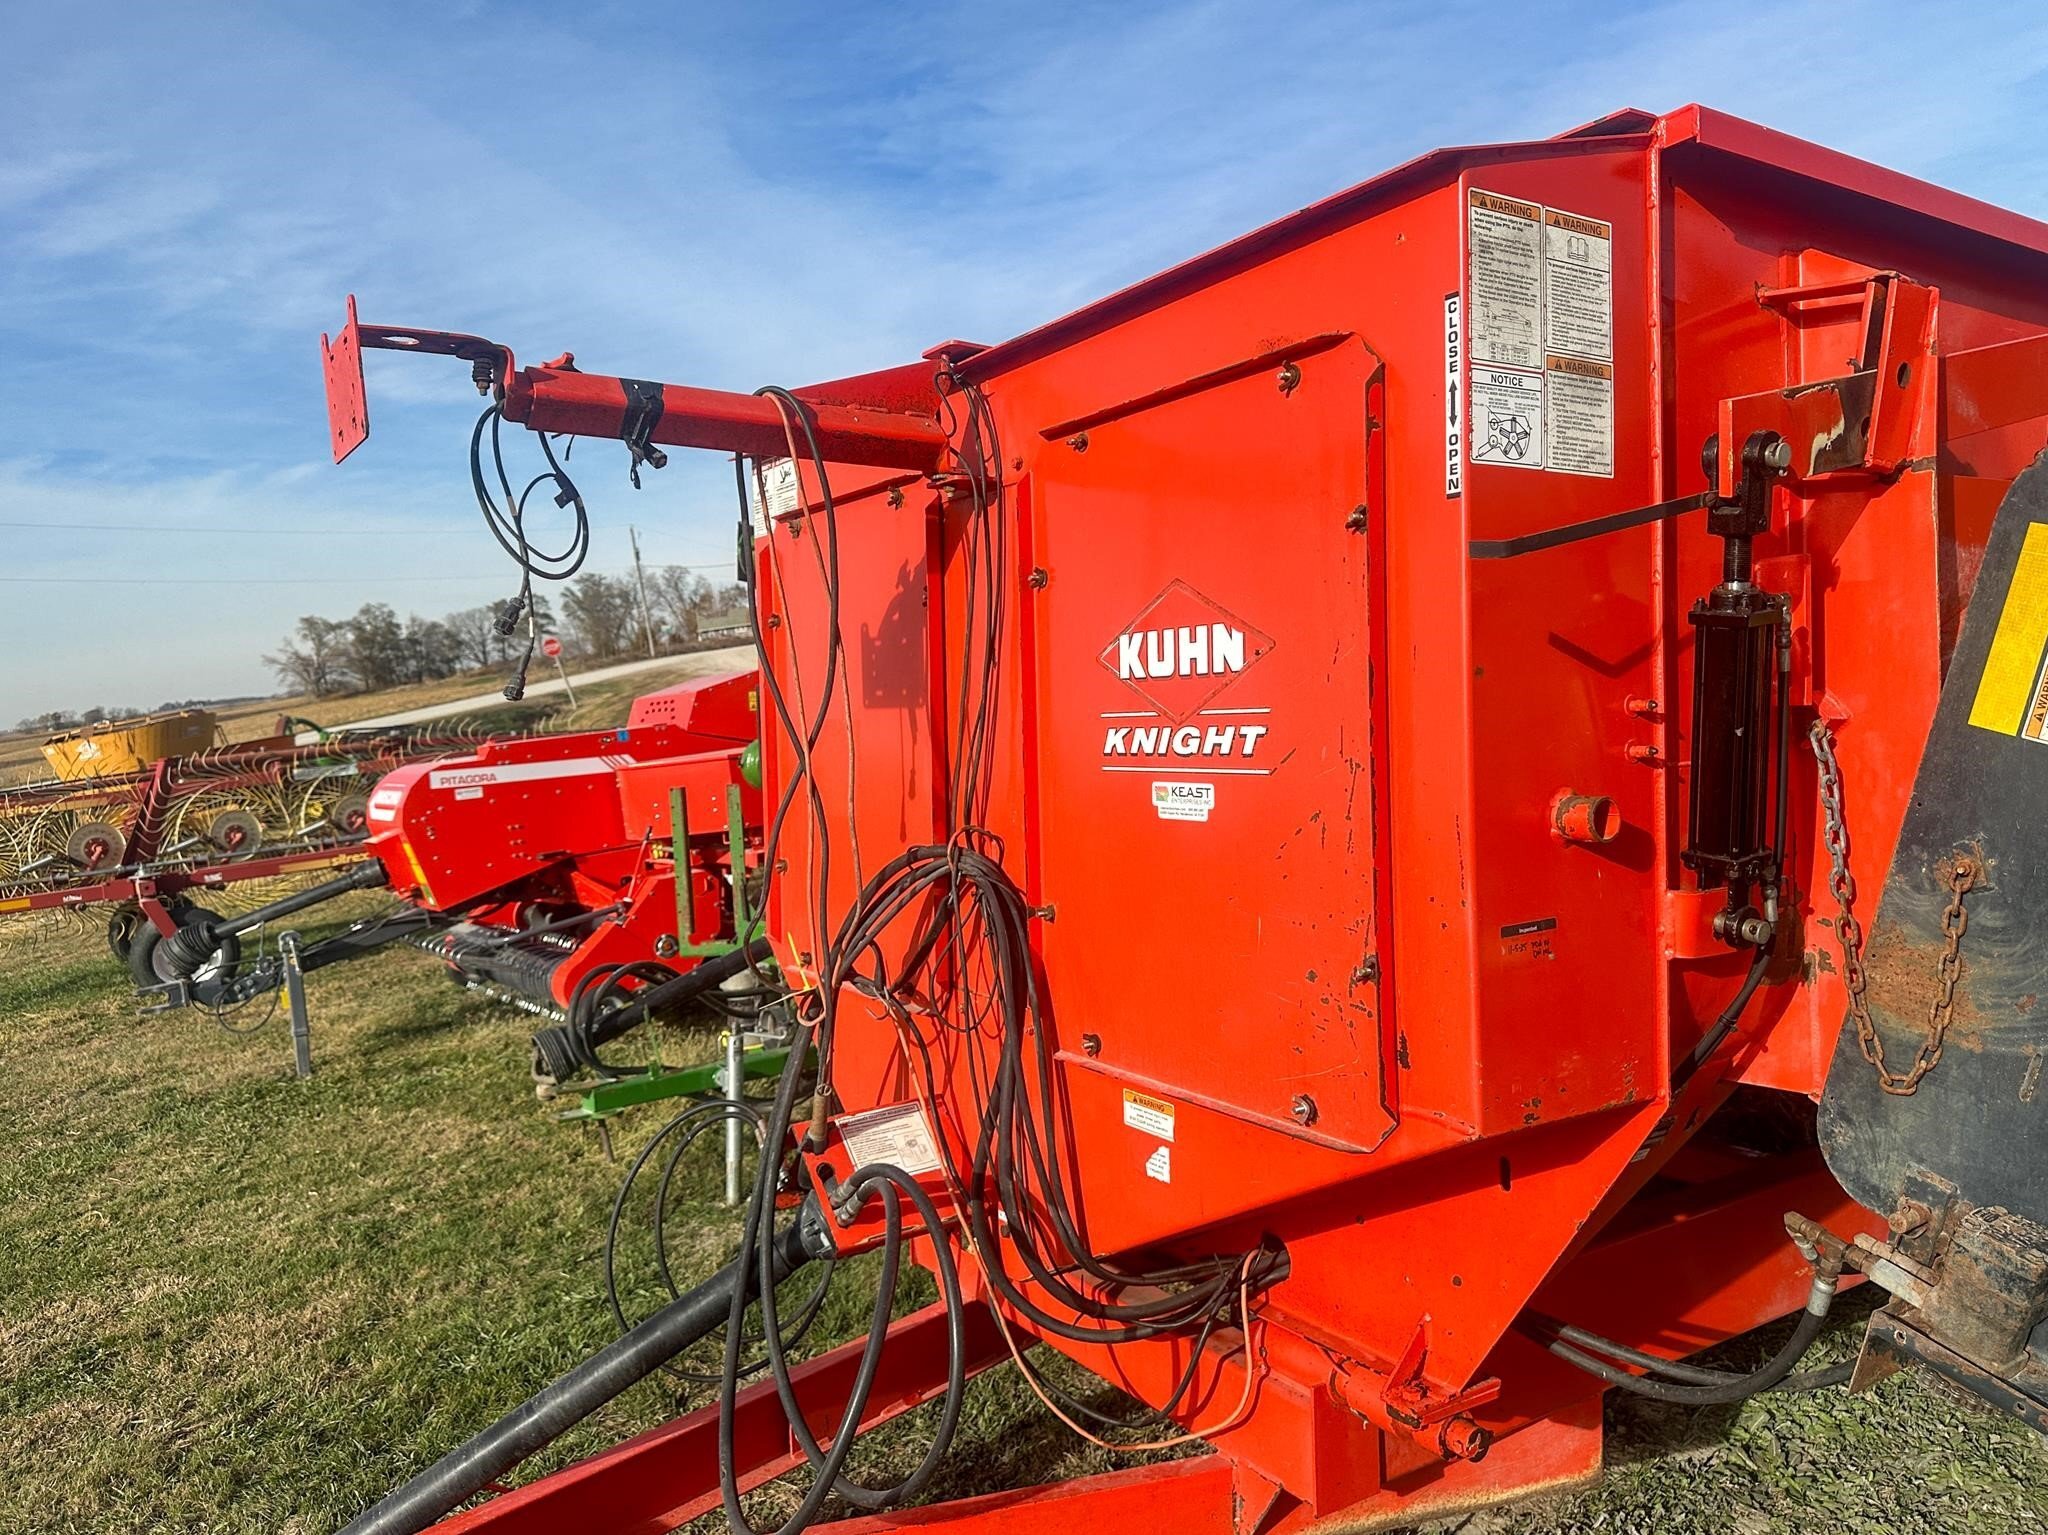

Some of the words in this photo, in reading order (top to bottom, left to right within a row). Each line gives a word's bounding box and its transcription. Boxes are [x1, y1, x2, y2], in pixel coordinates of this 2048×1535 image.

[1489, 199, 1532, 218] WARNING
[1563, 217, 1602, 236] WARNING
[1448, 300, 1458, 373] CLOSE
[1564, 361, 1604, 377] WARNING
[1490, 374, 1523, 387] NOTICE
[1448, 433, 1459, 490] OPEN
[1119, 623, 1245, 680] KUHN
[1103, 725, 1267, 757] KNIGHT
[440, 773, 497, 786] PITAGORA
[1171, 786, 1211, 798] KEAST
[1139, 1099, 1165, 1112] WARNING
